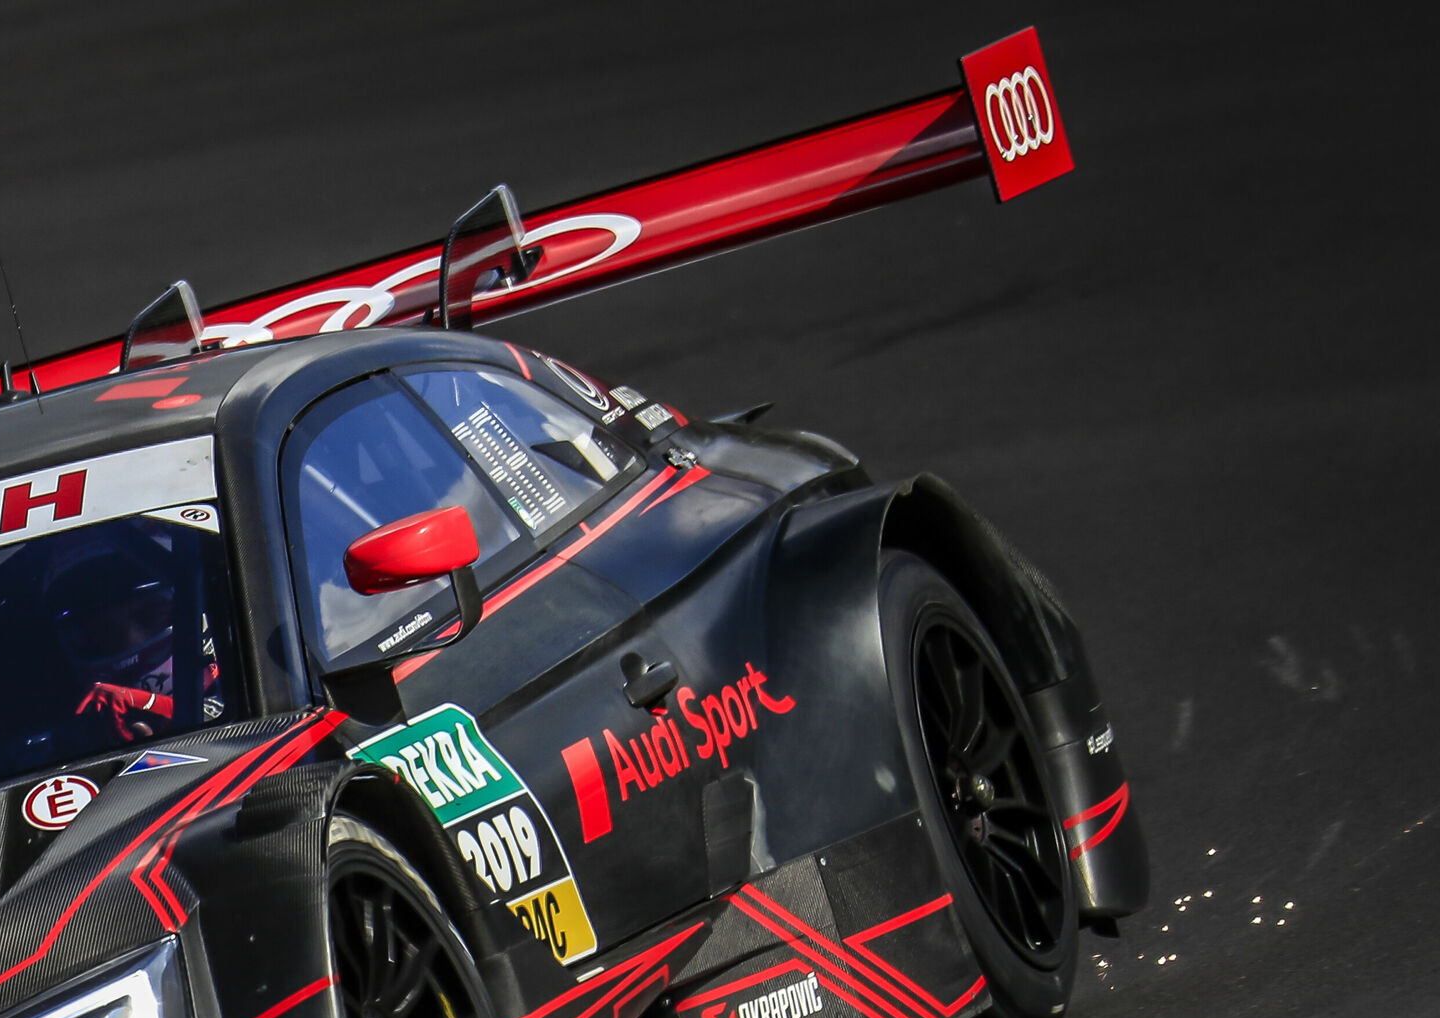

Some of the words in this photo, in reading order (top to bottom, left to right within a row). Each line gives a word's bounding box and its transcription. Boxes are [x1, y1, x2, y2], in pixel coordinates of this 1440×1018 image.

[602, 706, 690, 802] Audi
[677, 662, 796, 768] Sport
[457, 806, 543, 893] 2019
